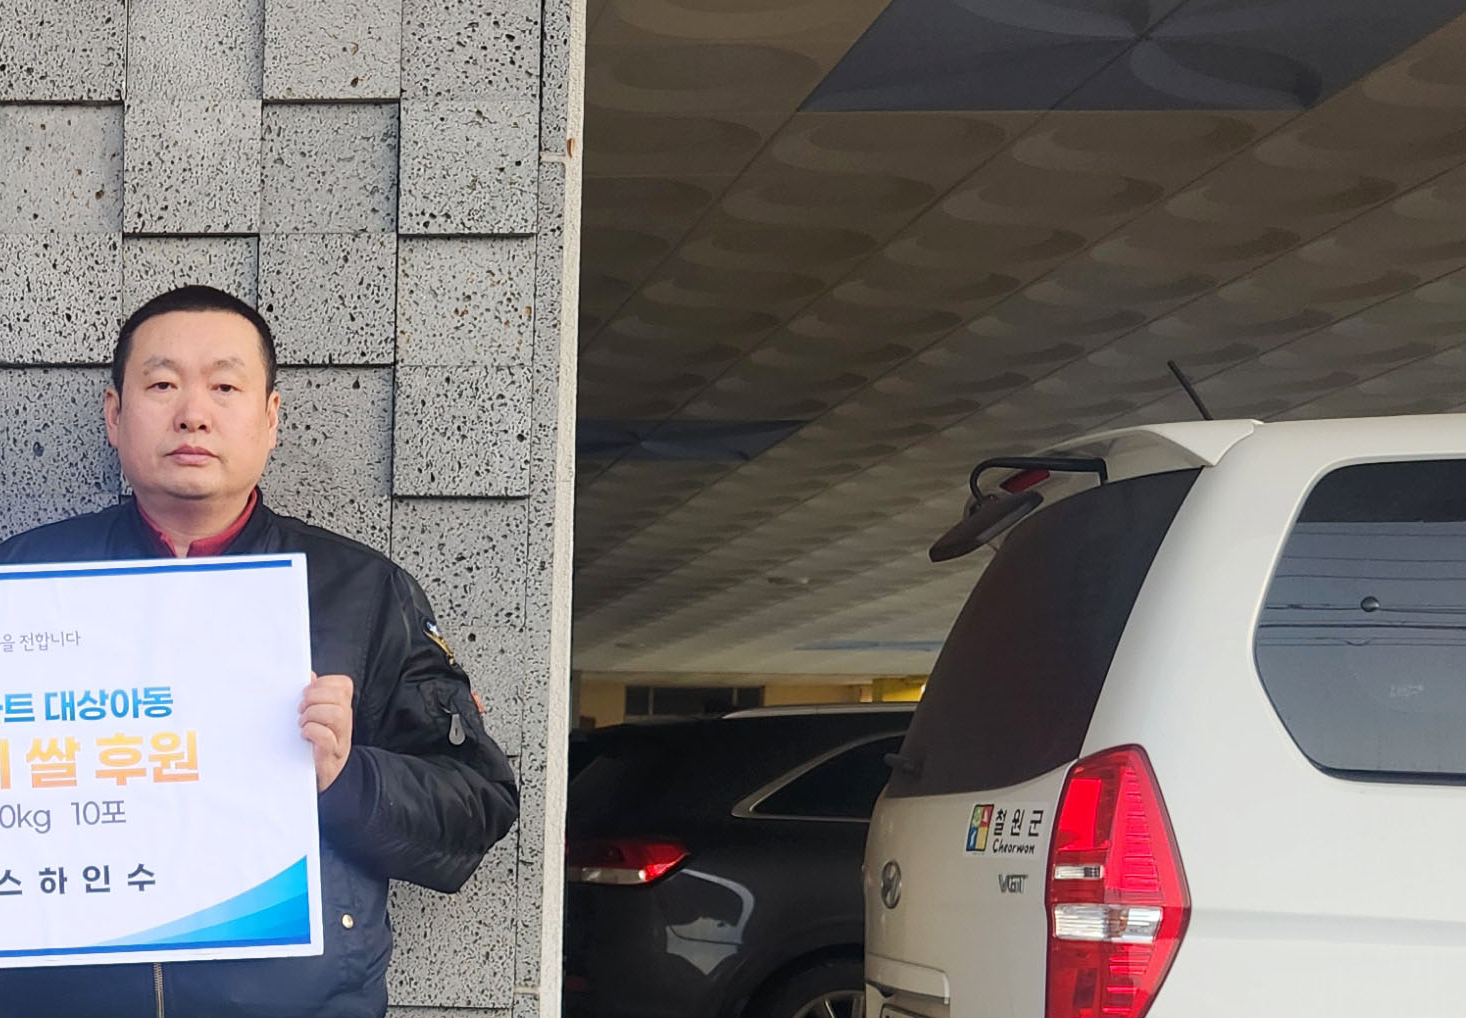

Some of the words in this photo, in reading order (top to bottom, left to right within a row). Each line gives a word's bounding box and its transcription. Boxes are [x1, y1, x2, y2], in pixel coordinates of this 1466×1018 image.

[19, 631, 82, 652] 전합니다
[44, 686, 174, 721] 대상아동
[26, 735, 82, 789] 쌀
[95, 730, 200, 786] 후원
[70, 799, 127, 826] 10포
[993, 838, 1036, 854] Cheorwon
[38, 866, 68, 895] 하
[82, 865, 111, 893] 인
[127, 863, 156, 891] 수
[998, 874, 1029, 893] VGT
